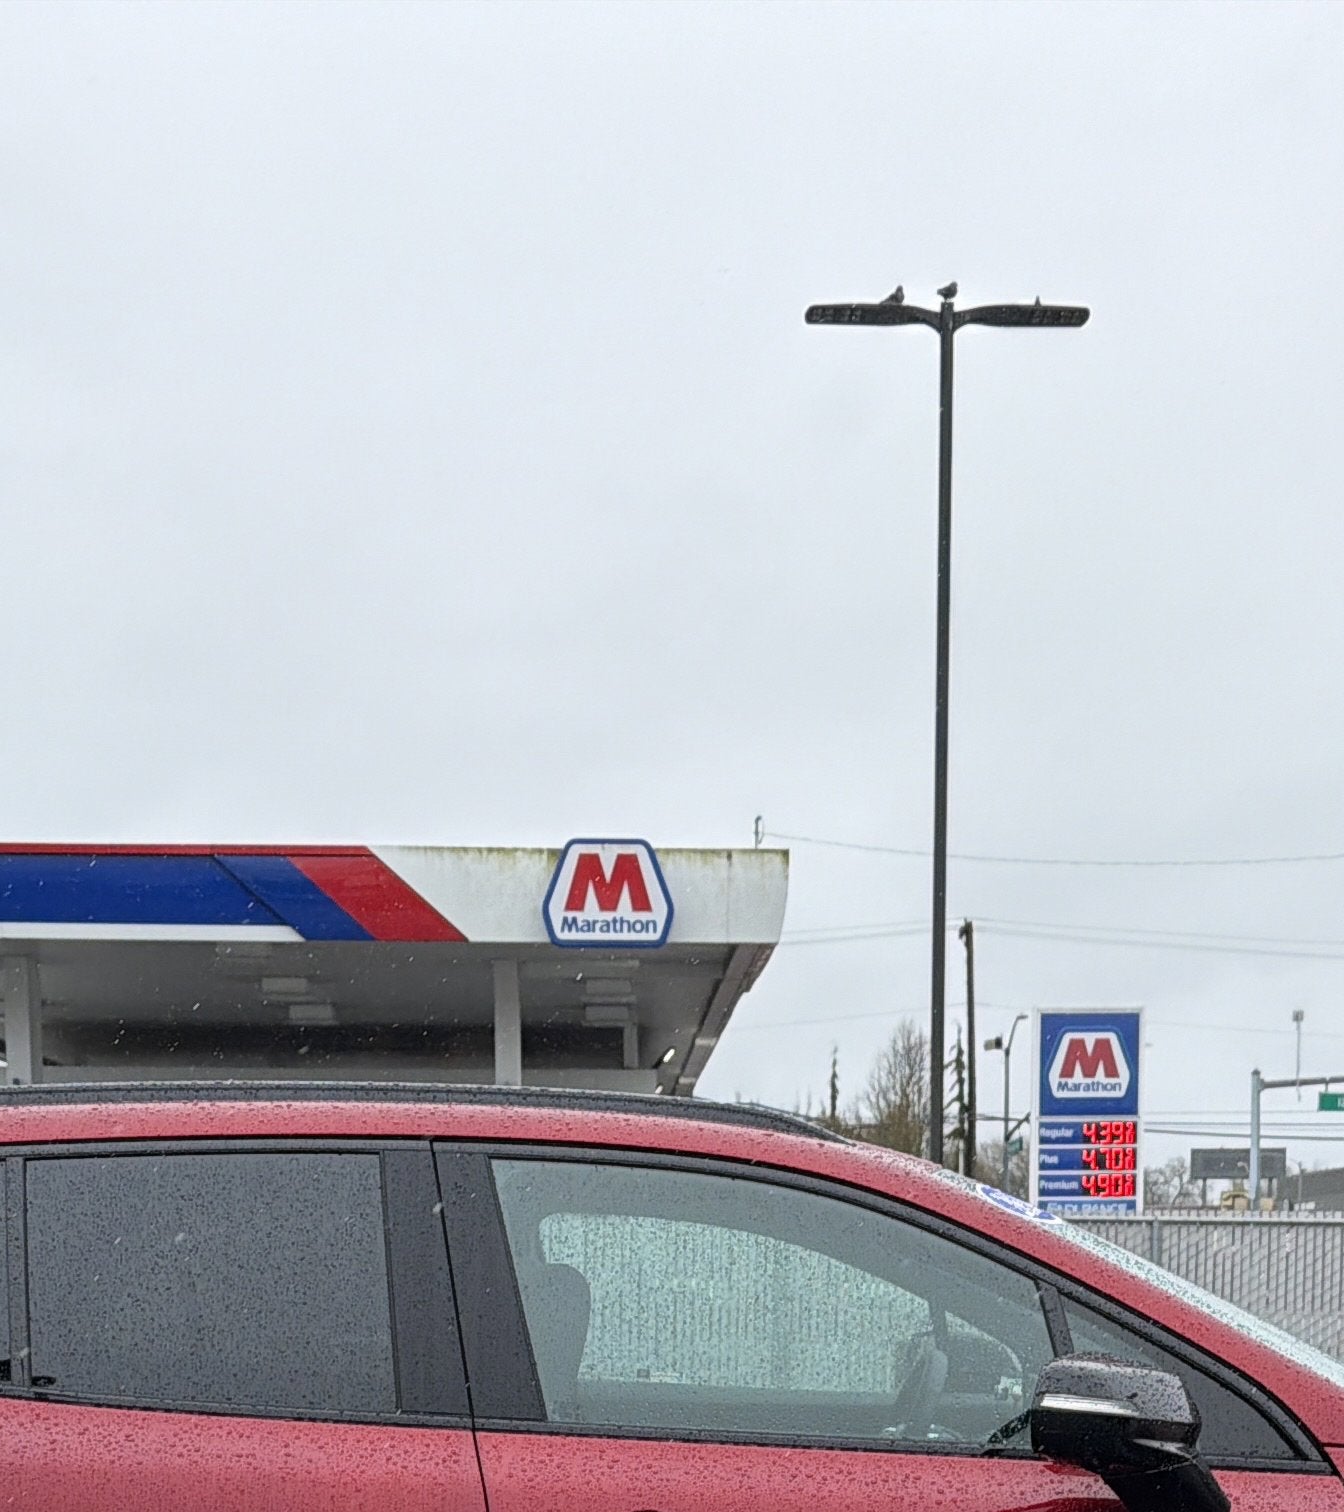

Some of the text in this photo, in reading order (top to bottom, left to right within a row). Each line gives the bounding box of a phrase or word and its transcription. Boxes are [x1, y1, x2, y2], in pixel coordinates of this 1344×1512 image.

[560, 916, 657, 934] Marathon
[1057, 1081, 1122, 1093] Marathon
[1039, 1127, 1074, 1139] Regular
[1039, 1153, 1059, 1164] Plus
[1039, 1180, 1079, 1190] Premium
